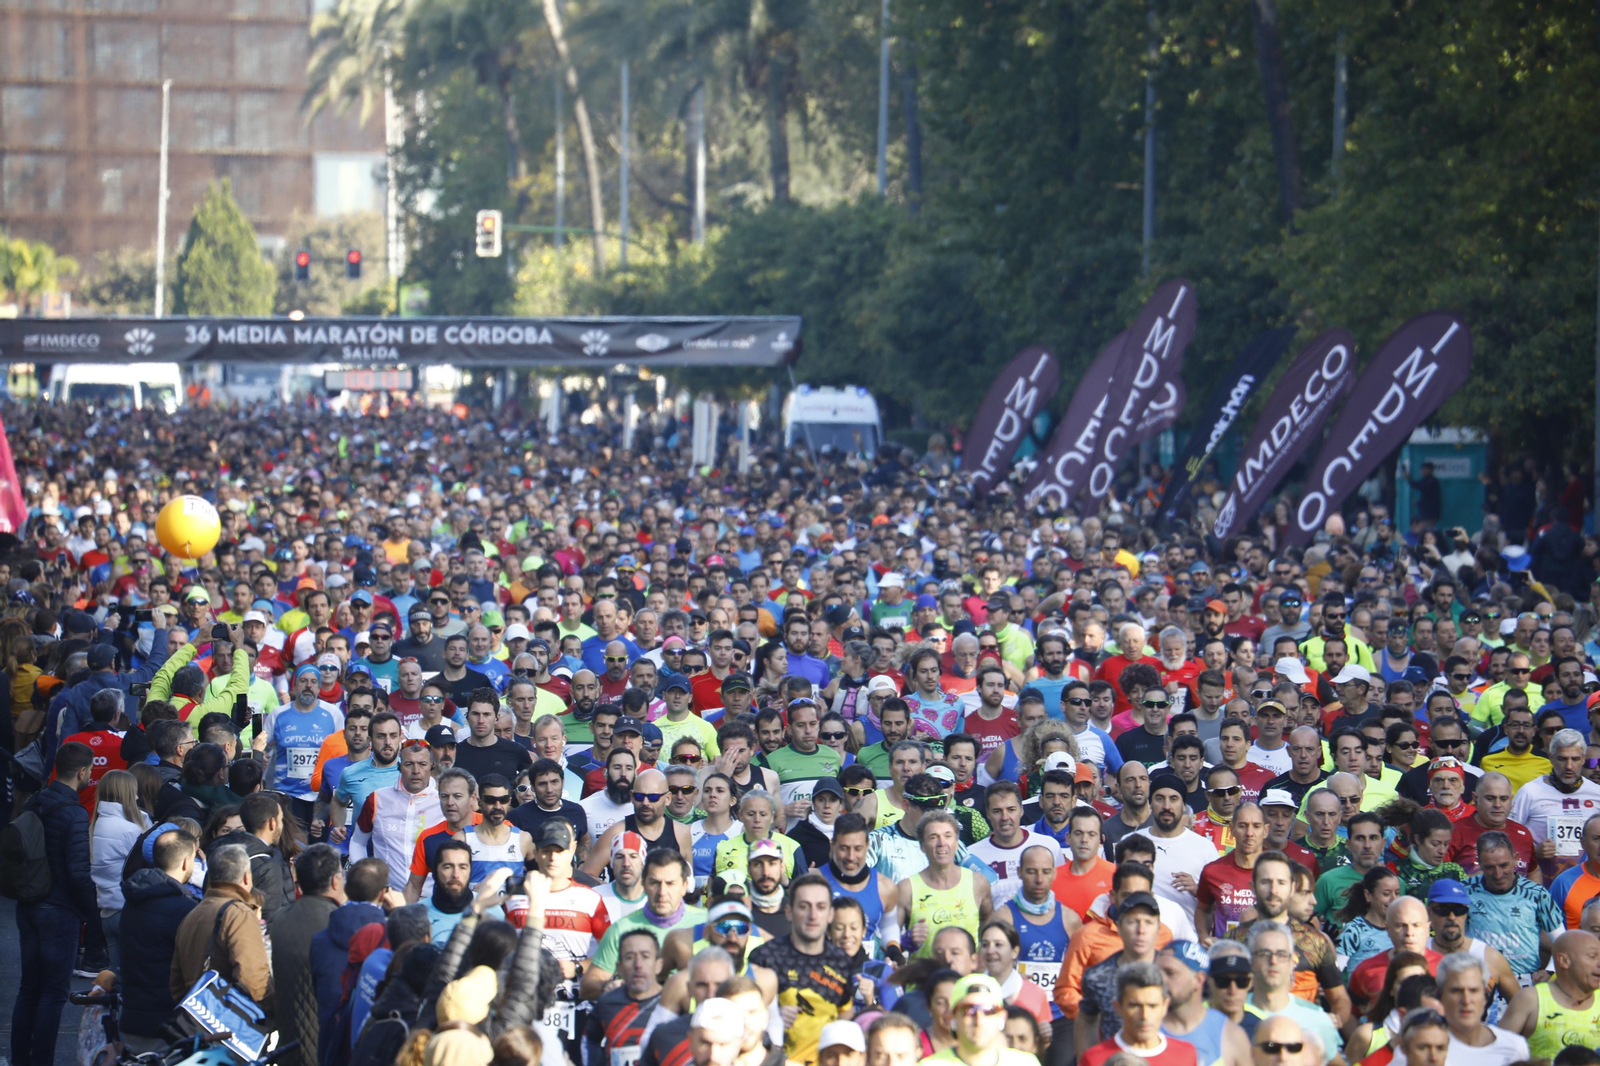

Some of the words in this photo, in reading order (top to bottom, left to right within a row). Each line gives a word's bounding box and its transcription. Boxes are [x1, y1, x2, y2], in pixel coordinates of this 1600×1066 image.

[40, 333, 100, 348] IMDECO
[185, 325, 210, 344] 36
[217, 326, 287, 344] MEDIA
[294, 322, 405, 344] MARATÓN
[410, 325, 438, 344] DE
[444, 322, 553, 344] CÓRDOBA
[342, 346, 399, 360] SALIDA
[1088, 284, 1188, 498] IMDECO
[1235, 344, 1347, 494] IMDECO
[1298, 321, 1460, 532] IMDECO
[981, 734, 1003, 743] MEDIA
[386, 823, 397, 832] 36
[1220, 895, 1231, 905] 36
